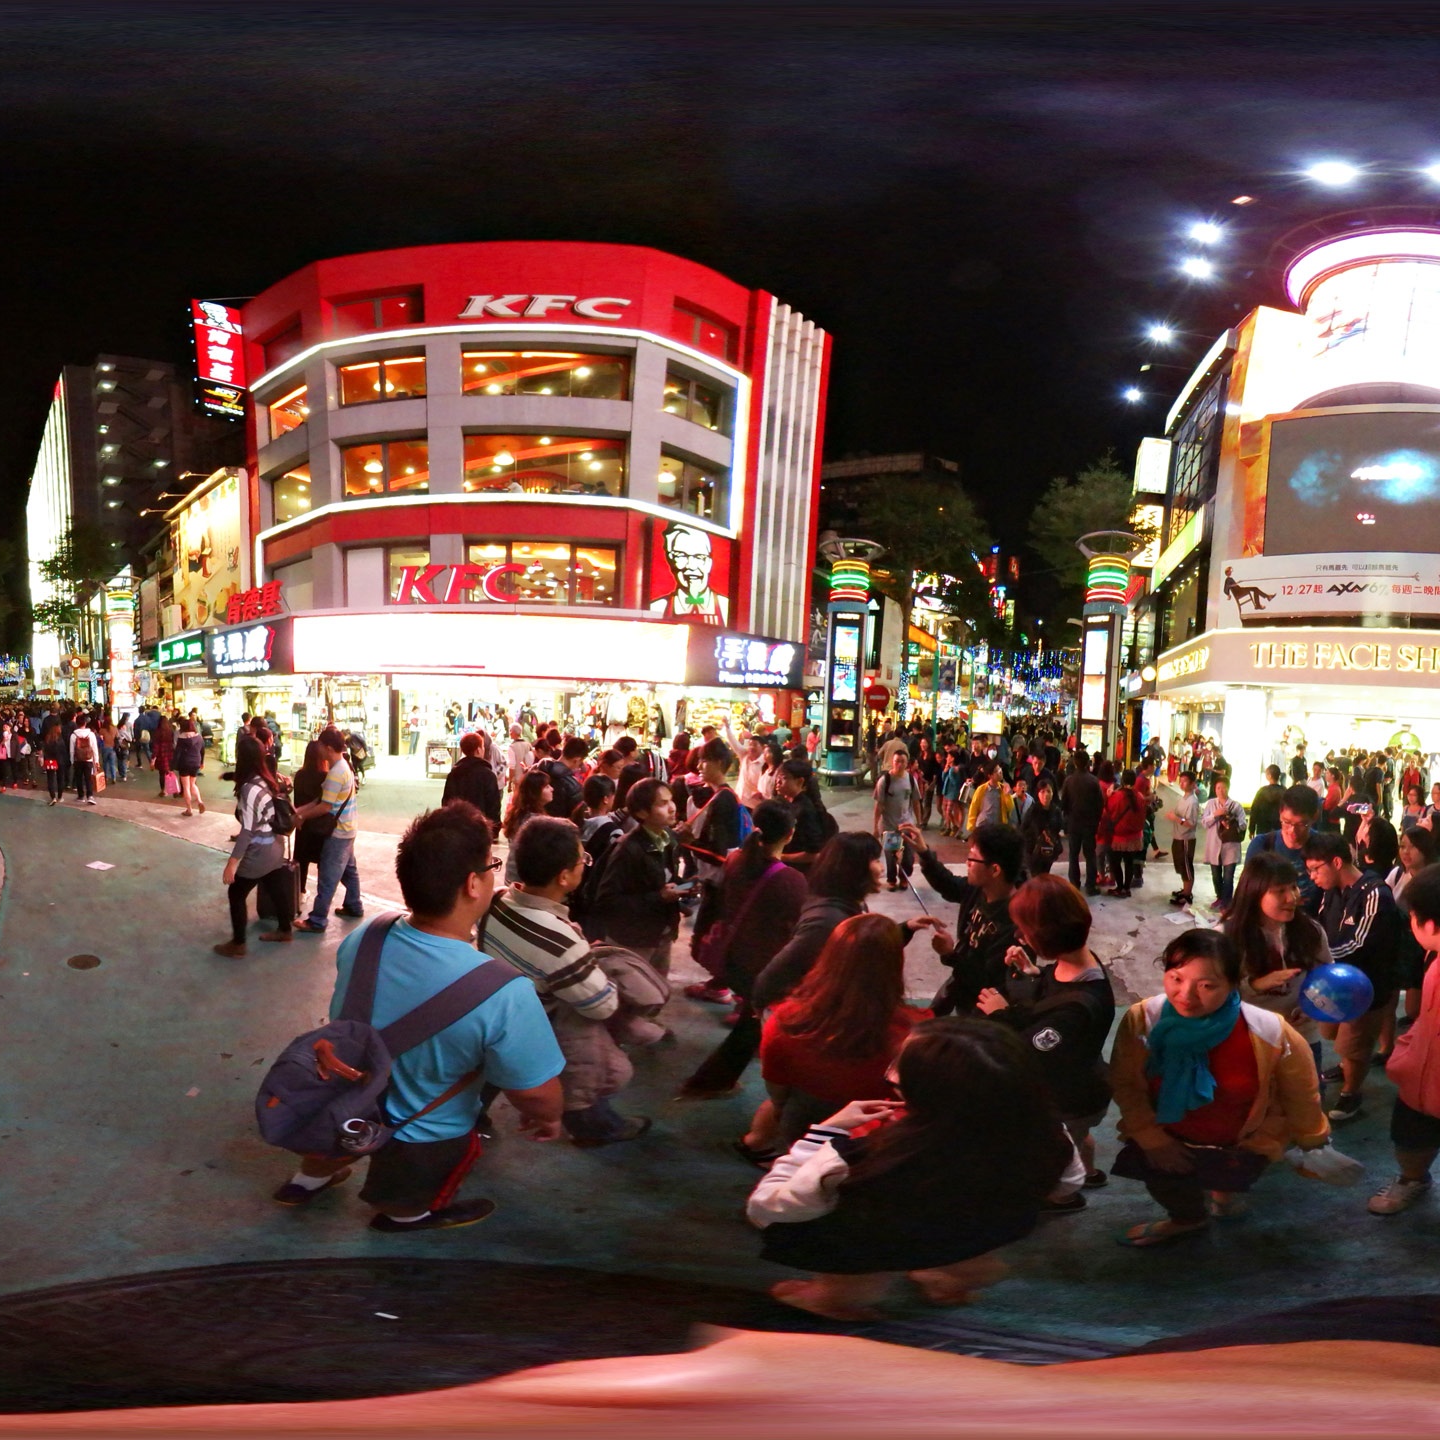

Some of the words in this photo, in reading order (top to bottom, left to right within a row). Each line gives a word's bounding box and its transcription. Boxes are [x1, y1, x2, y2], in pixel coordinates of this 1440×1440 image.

[458, 295, 631, 320] KFC
[392, 563, 526, 604] KFC
[226, 580, 283, 625] 肯德基
[1250, 641, 1308, 669] THE
[1313, 641, 1391, 671] FACE
[1396, 643, 1440, 674] SH
